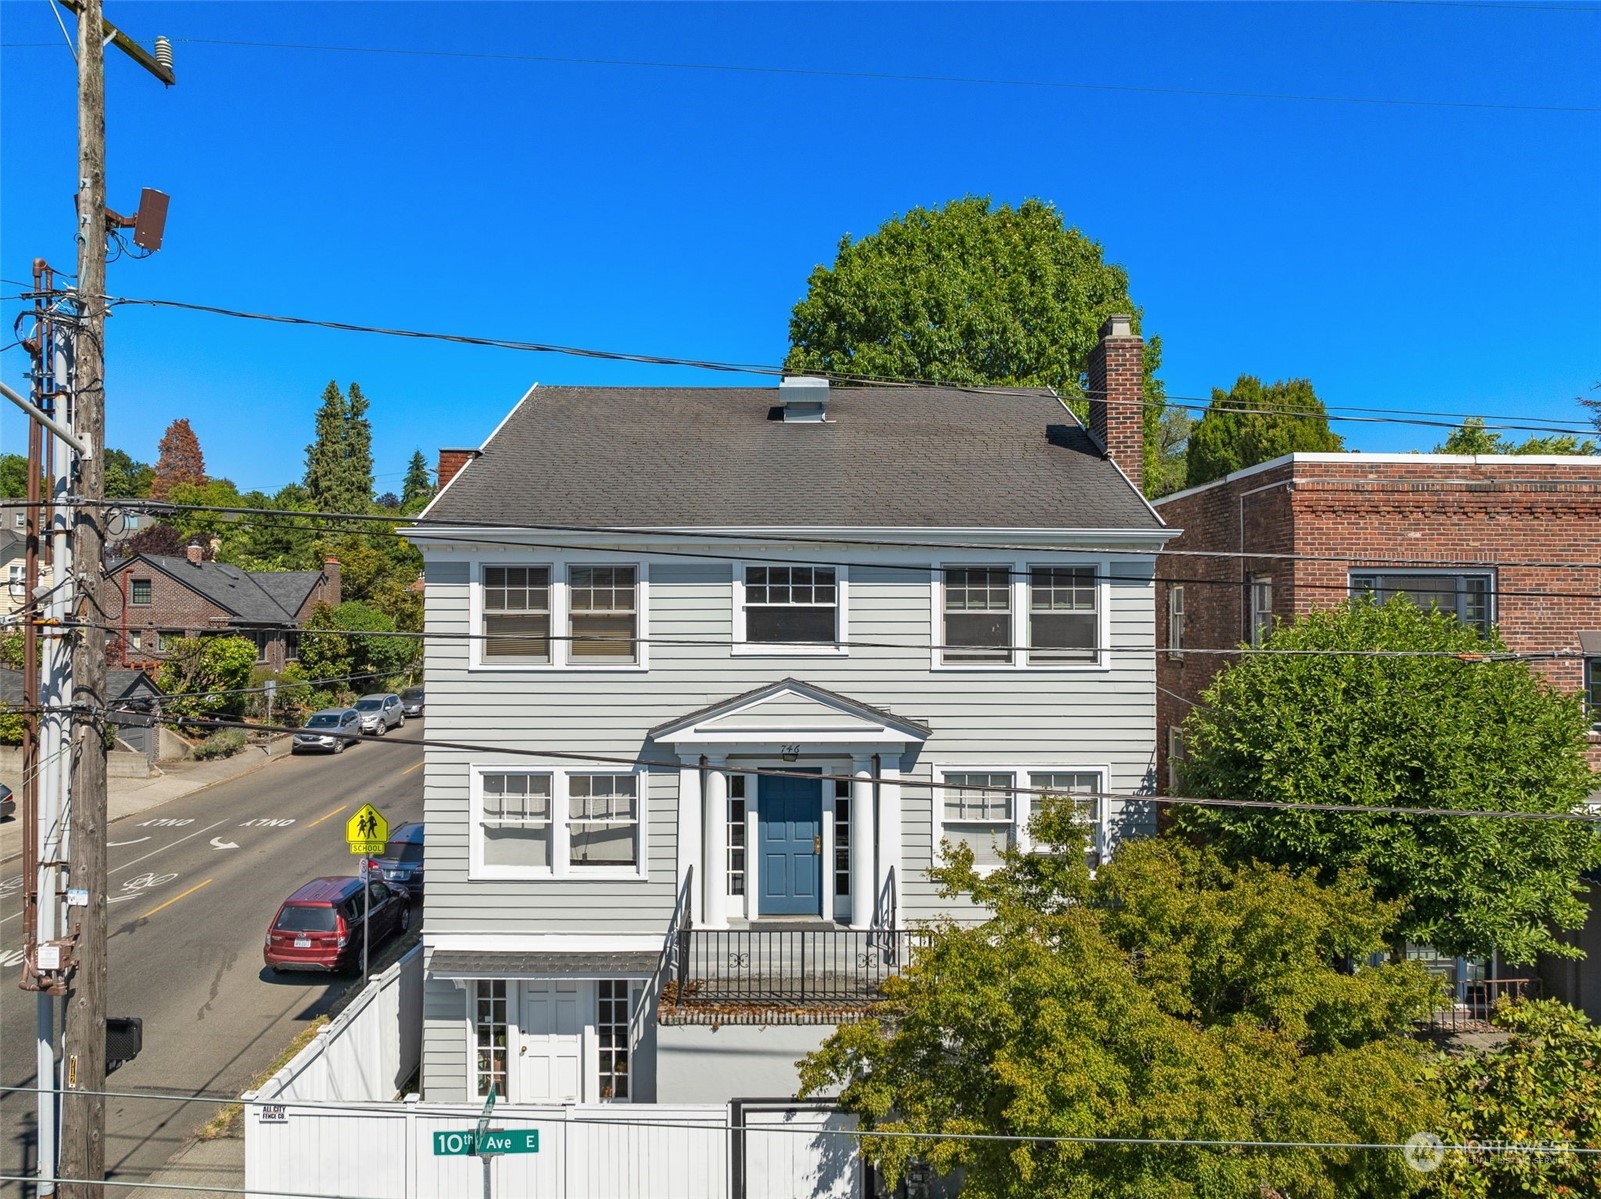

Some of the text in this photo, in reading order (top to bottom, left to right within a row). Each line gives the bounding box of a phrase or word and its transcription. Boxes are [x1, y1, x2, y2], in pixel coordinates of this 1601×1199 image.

[781, 744, 801, 754] 746
[237, 818, 297, 828] ONLY
[353, 844, 382, 852] SCHOOL
[486, 1136, 512, 1150] Ave
[526, 1135, 535, 1148] E
